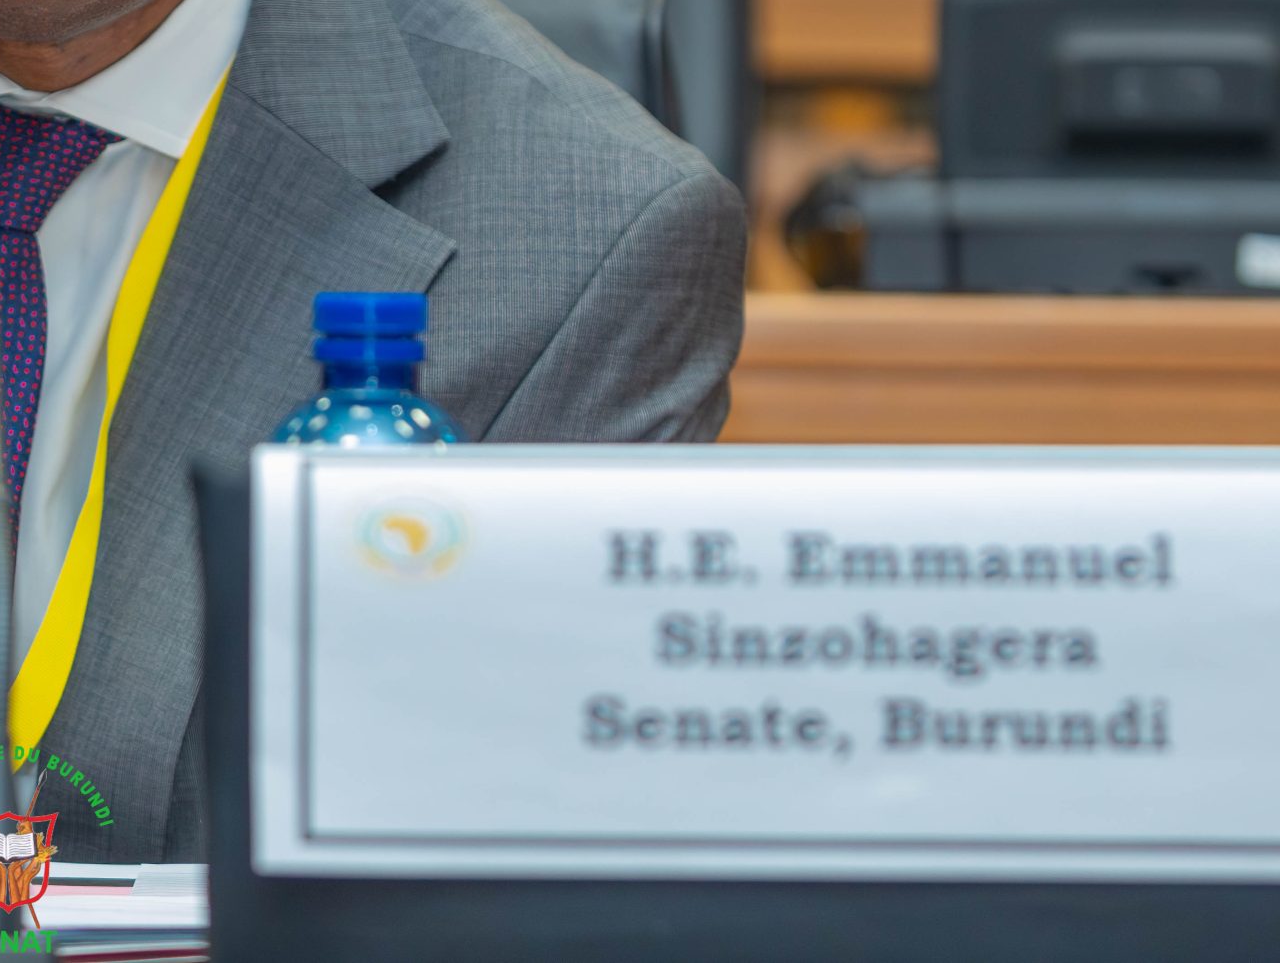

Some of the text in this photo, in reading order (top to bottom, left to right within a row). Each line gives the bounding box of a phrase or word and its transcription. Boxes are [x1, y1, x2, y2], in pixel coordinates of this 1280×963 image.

[605, 530, 1176, 586] H.E. Emmanuel
[656, 613, 1099, 678] Sinzohagera
[583, 696, 1172, 758] Senate, Burundi
